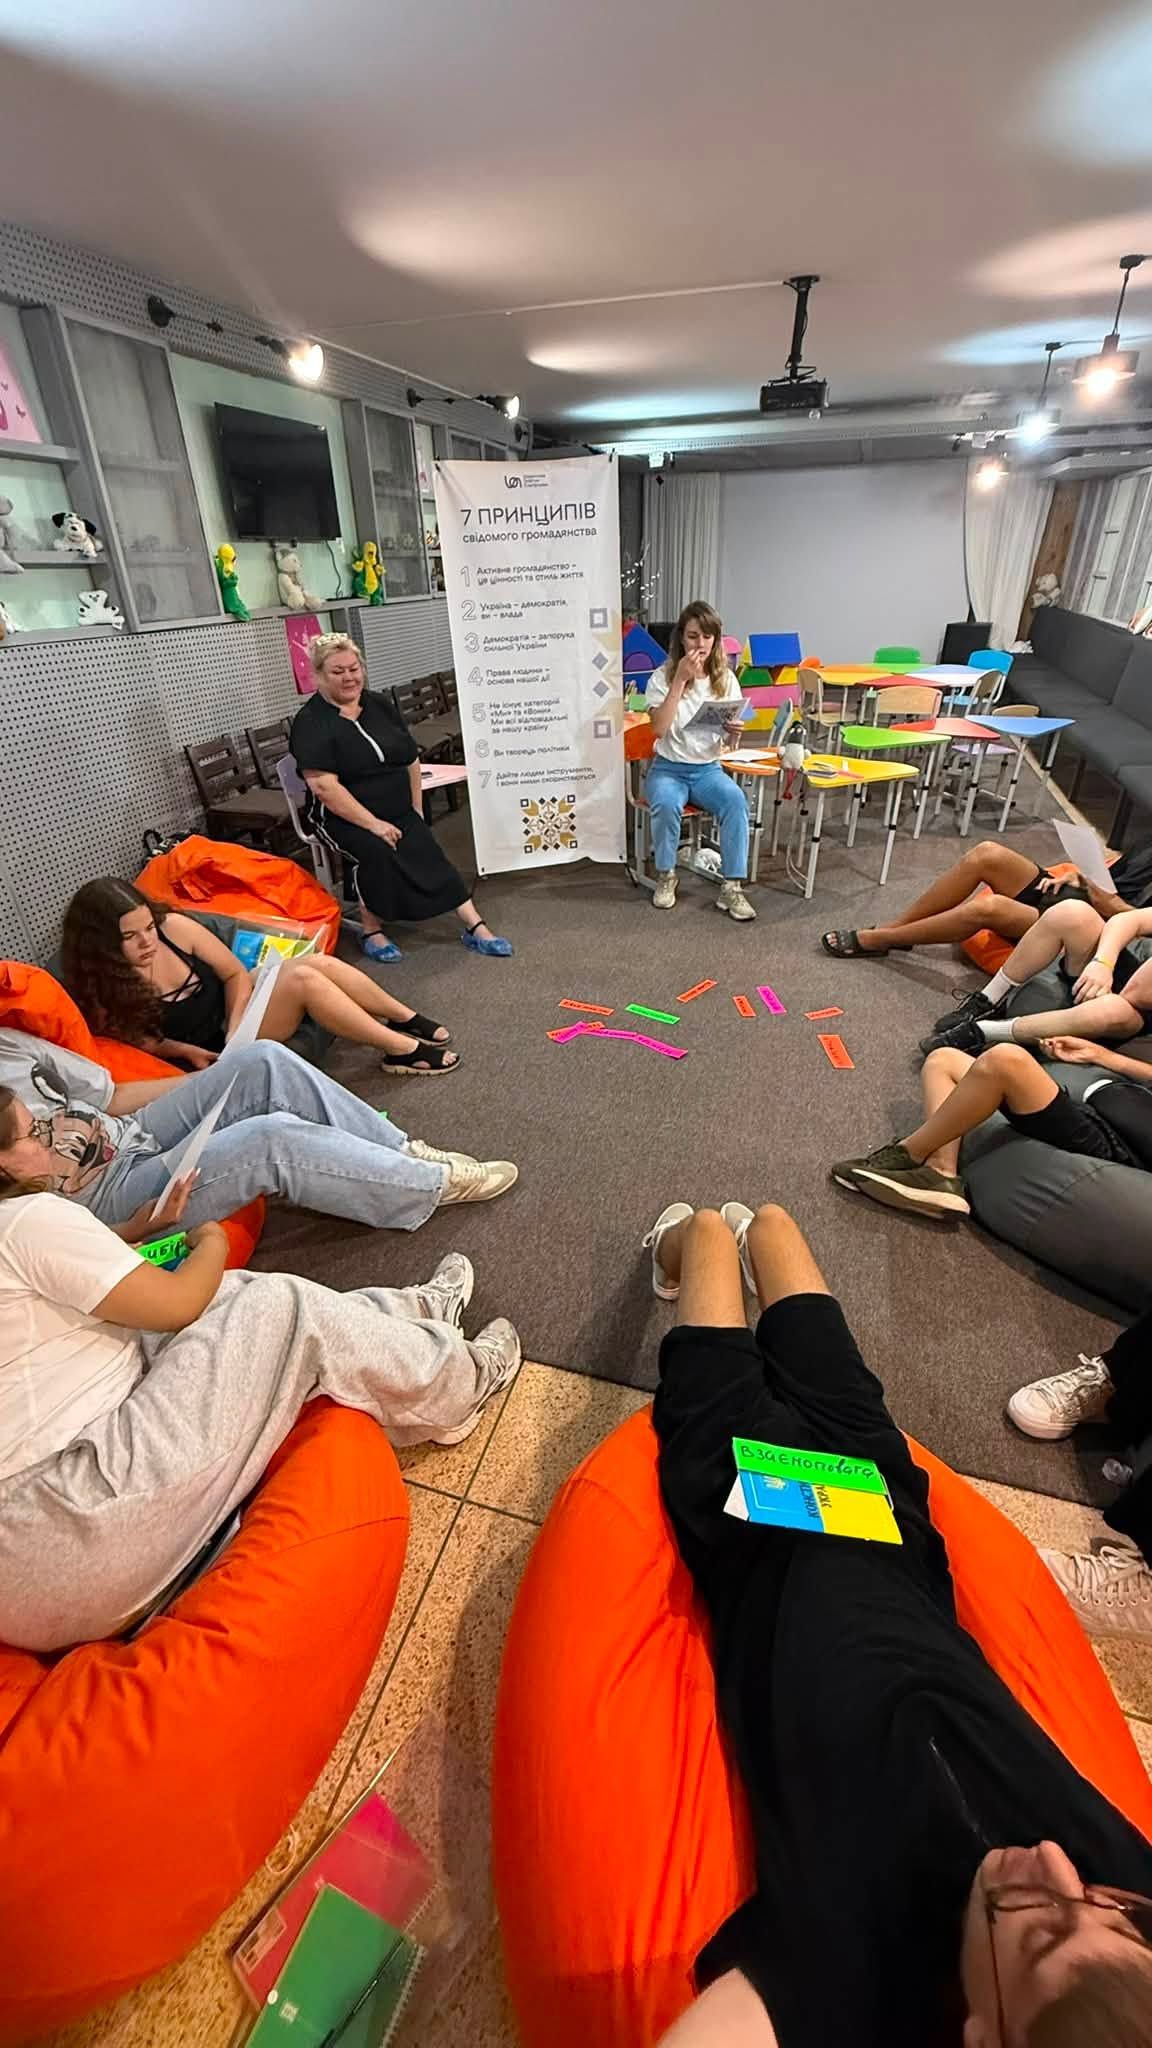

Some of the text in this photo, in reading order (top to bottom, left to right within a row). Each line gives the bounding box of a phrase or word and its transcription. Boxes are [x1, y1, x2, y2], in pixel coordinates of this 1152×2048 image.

[460, 502, 597, 526] 7 ПРИНЦИПІВ
[462, 527, 597, 544] свідомого громадянства
[460, 565, 471, 588] 1
[512, 563, 570, 574] громадянство
[489, 575, 524, 585] цінності
[535, 573, 559, 581] стиль
[559, 571, 584, 579] життя
[460, 599, 477, 621] 2
[480, 603, 512, 612] Україна
[499, 611, 524, 619] влада
[463, 631, 480, 654] 3
[483, 635, 530, 644] Демократія
[539, 632, 575, 641] запорука
[483, 641, 548, 653] сильної України
[467, 666, 483, 686] 4
[485, 669, 511, 678] Права
[513, 667, 543, 675] людини
[486, 678, 515, 686] основа
[471, 702, 487, 723] 5
[474, 738, 490, 759] 6
[478, 769, 492, 789] 7
[147, 1240, 184, 1258] ибір
